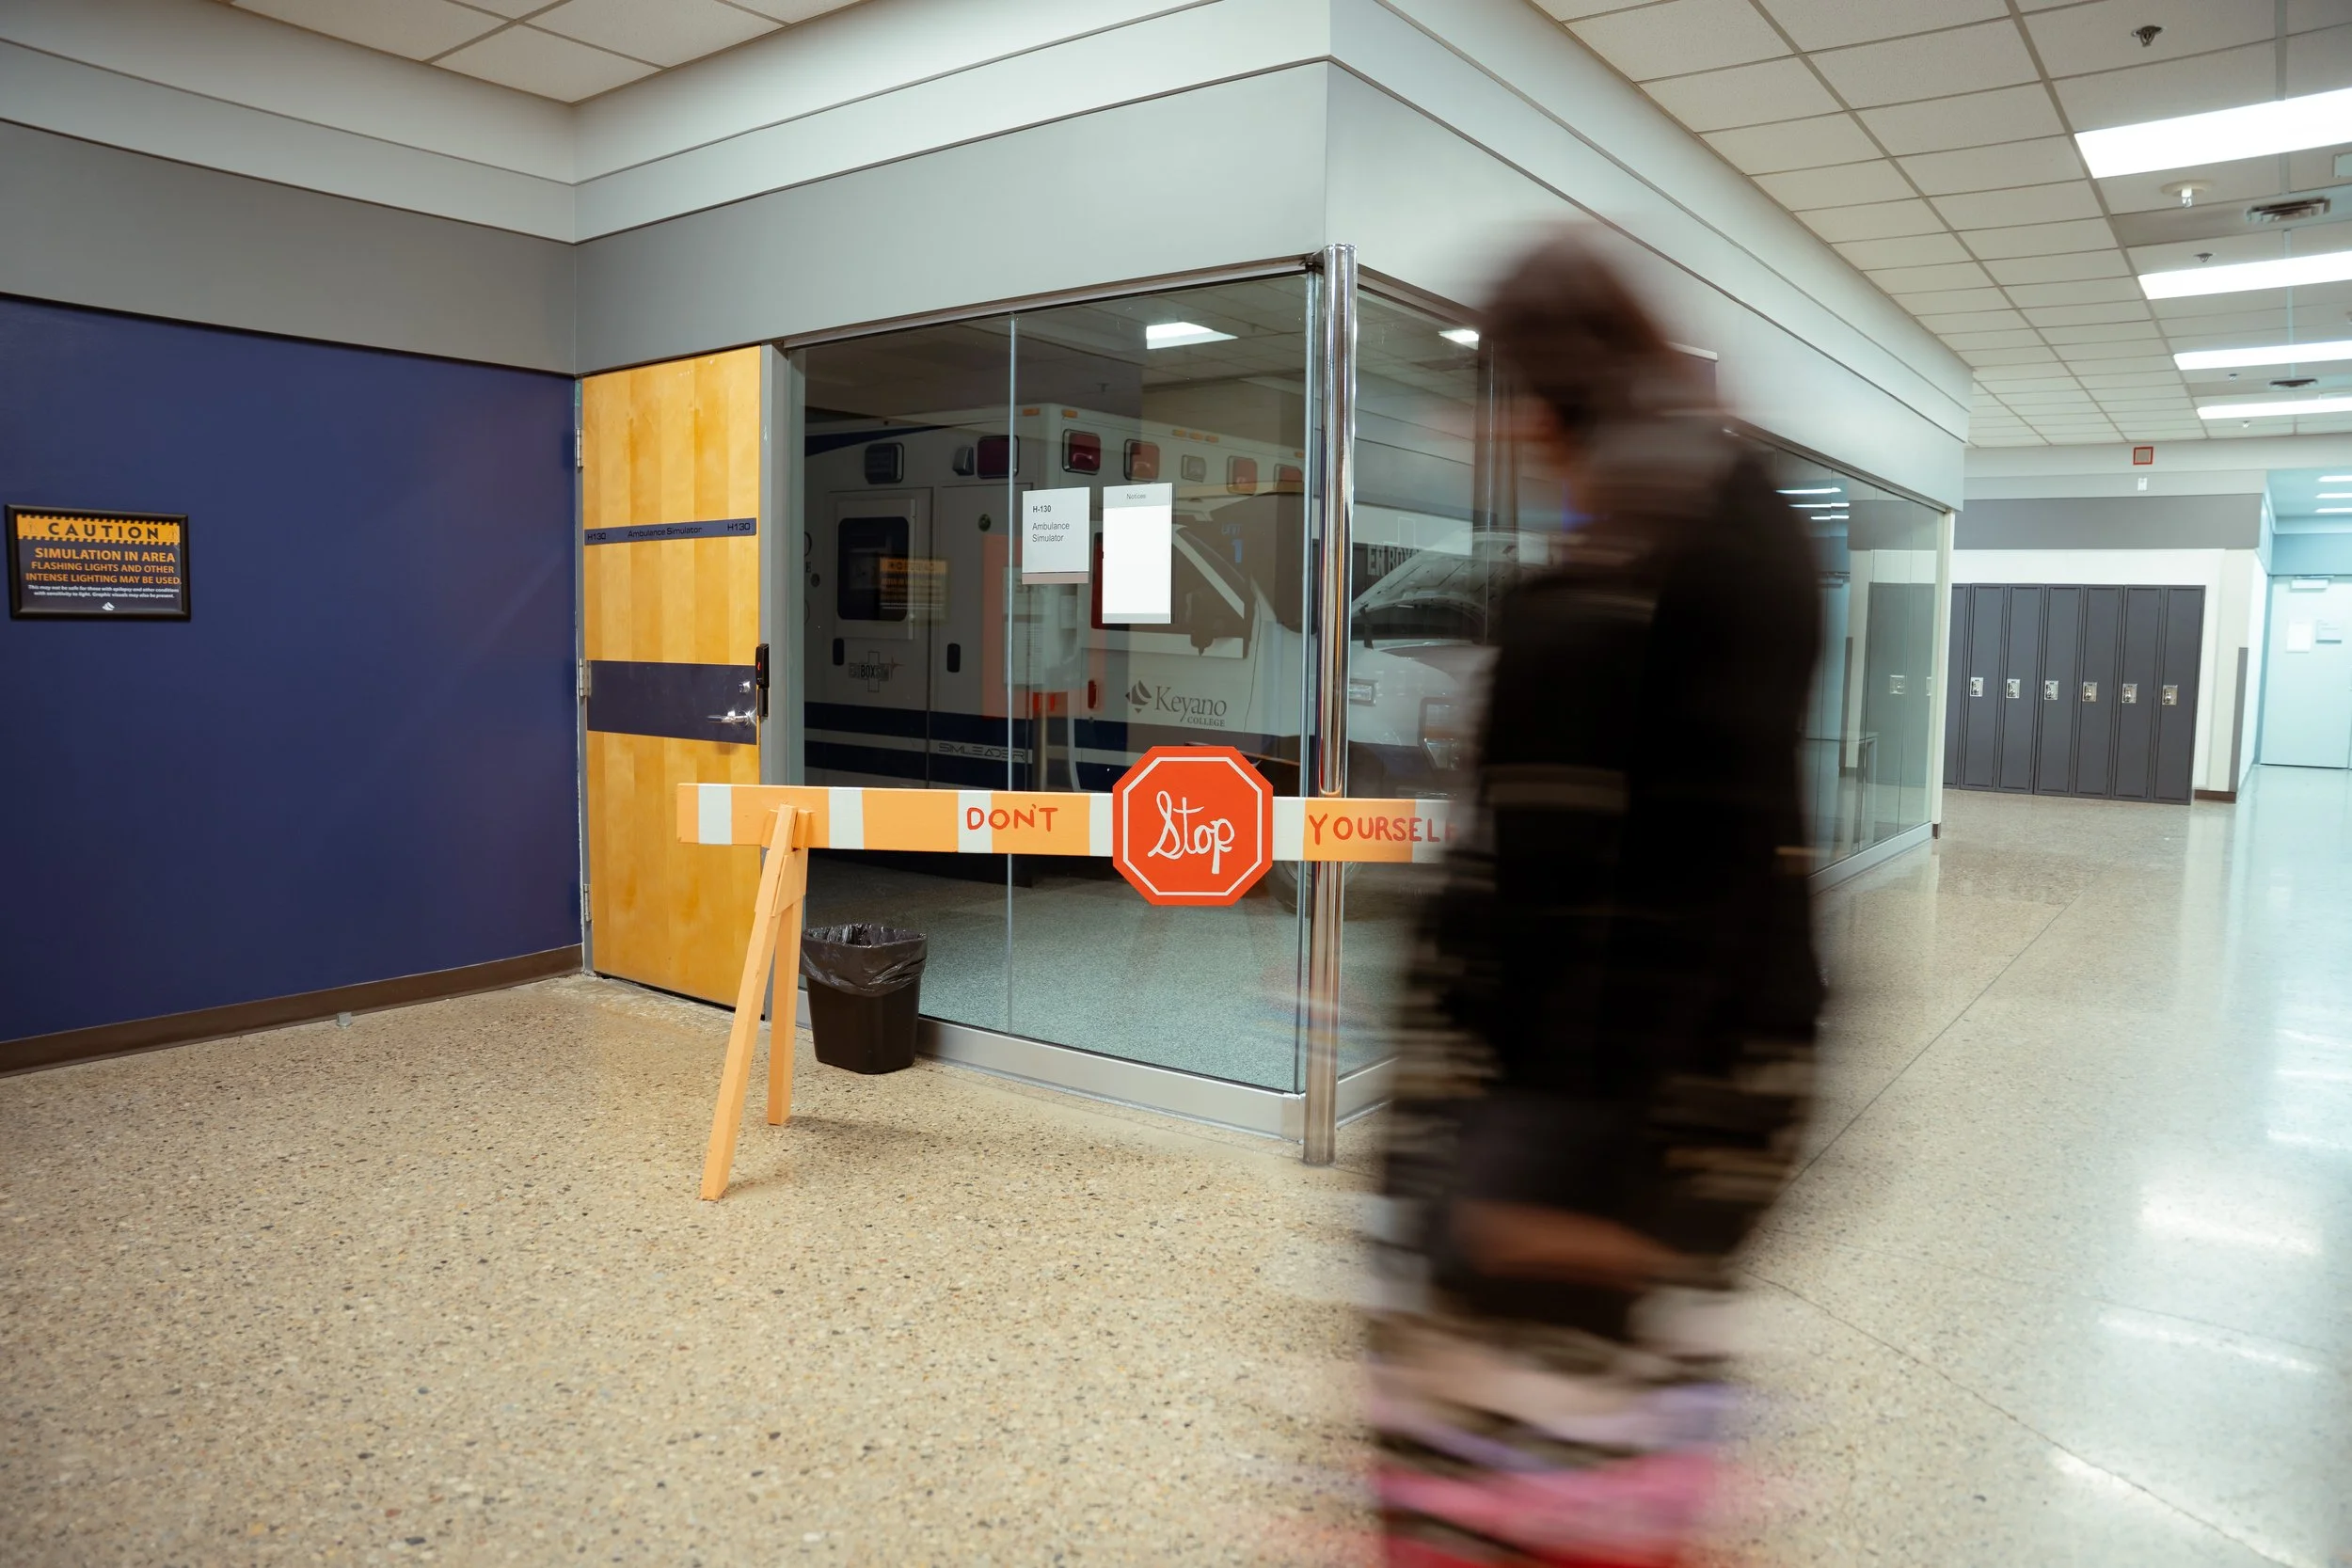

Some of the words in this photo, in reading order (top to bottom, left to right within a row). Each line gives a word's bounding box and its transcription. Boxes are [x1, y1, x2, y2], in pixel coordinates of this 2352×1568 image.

[1125, 492, 1147, 500] Notices
[1032, 505, 1052, 514] H-130
[48, 522, 158, 540] CAUTION
[587, 532, 607, 542] H130
[628, 529, 666, 538] Ambulance
[666, 527, 703, 536] Simulator
[727, 522, 751, 532] H130
[1032, 521, 1071, 531] Ambulance
[1032, 533, 1064, 544] Simulator
[35, 547, 121, 561] SIMULATION
[124, 551, 138, 562] IN
[141, 551, 176, 563] AREA
[31, 561, 82, 571] FLASHING
[85, 562, 119, 573] LIGHTS
[120, 564, 142, 573] AND
[144, 565, 175, 574] OTHER
[25, 572, 69, 582] INTENSE
[71, 574, 118, 583] LIGHTING
[119, 576, 140, 584] MAY
[142, 576, 153, 585] BE
[1154, 685, 1228, 722] Keyano
[1186, 716, 1226, 727] COLLEGE
[966, 802, 1058, 832] DON'T
[1147, 790, 1235, 875] Stop
